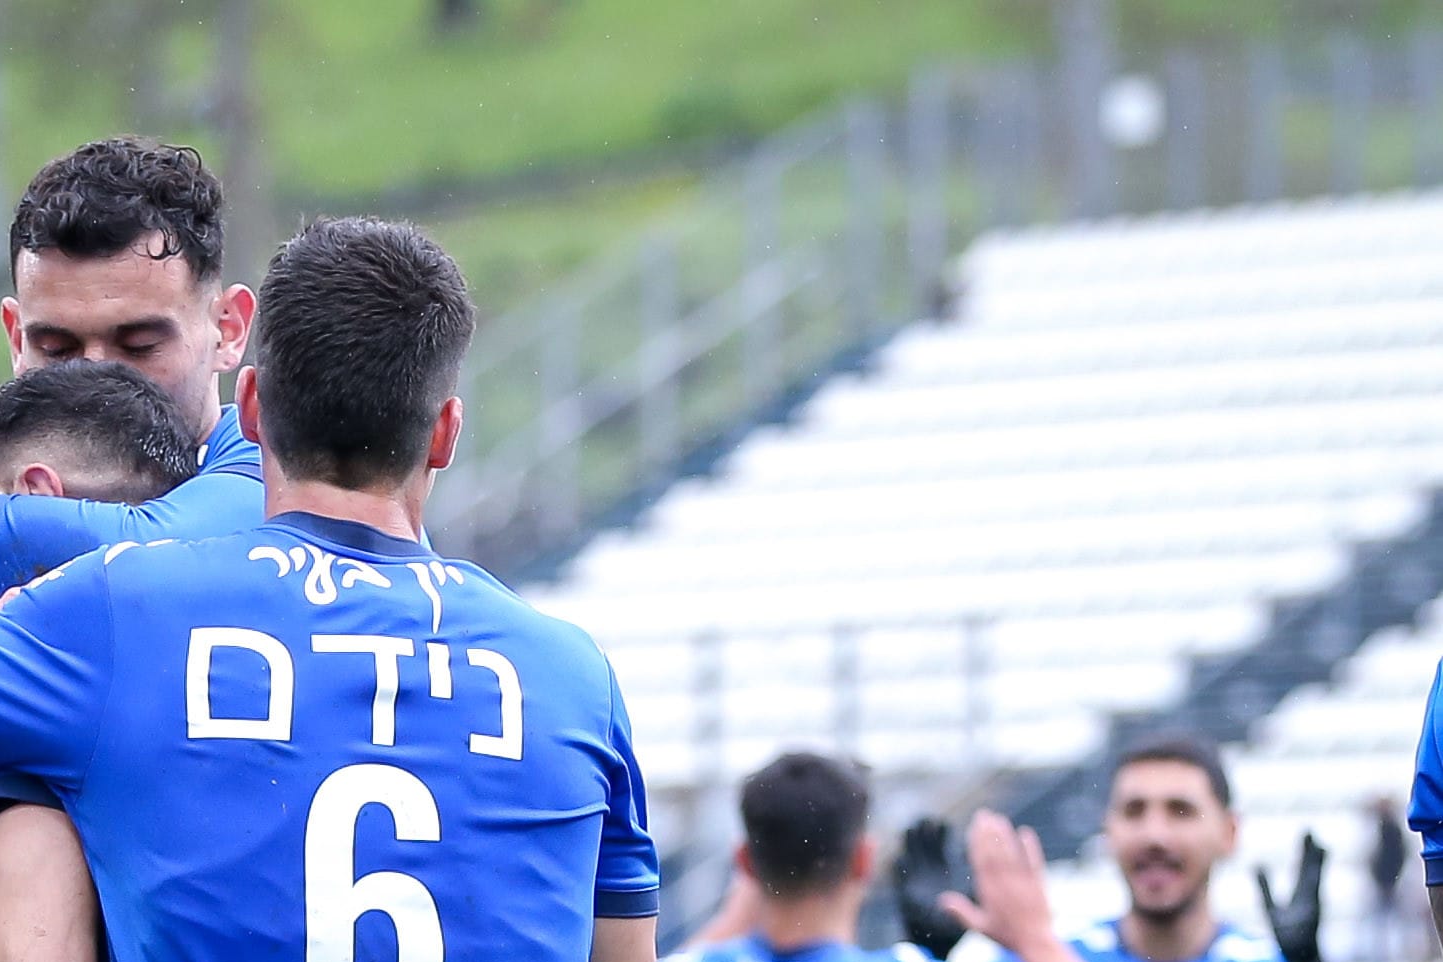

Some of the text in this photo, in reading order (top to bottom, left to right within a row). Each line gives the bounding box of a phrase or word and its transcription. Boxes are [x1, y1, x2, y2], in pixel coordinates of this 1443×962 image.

[248, 541, 464, 634] יין בעיר
[185, 626, 525, 761] נידם
